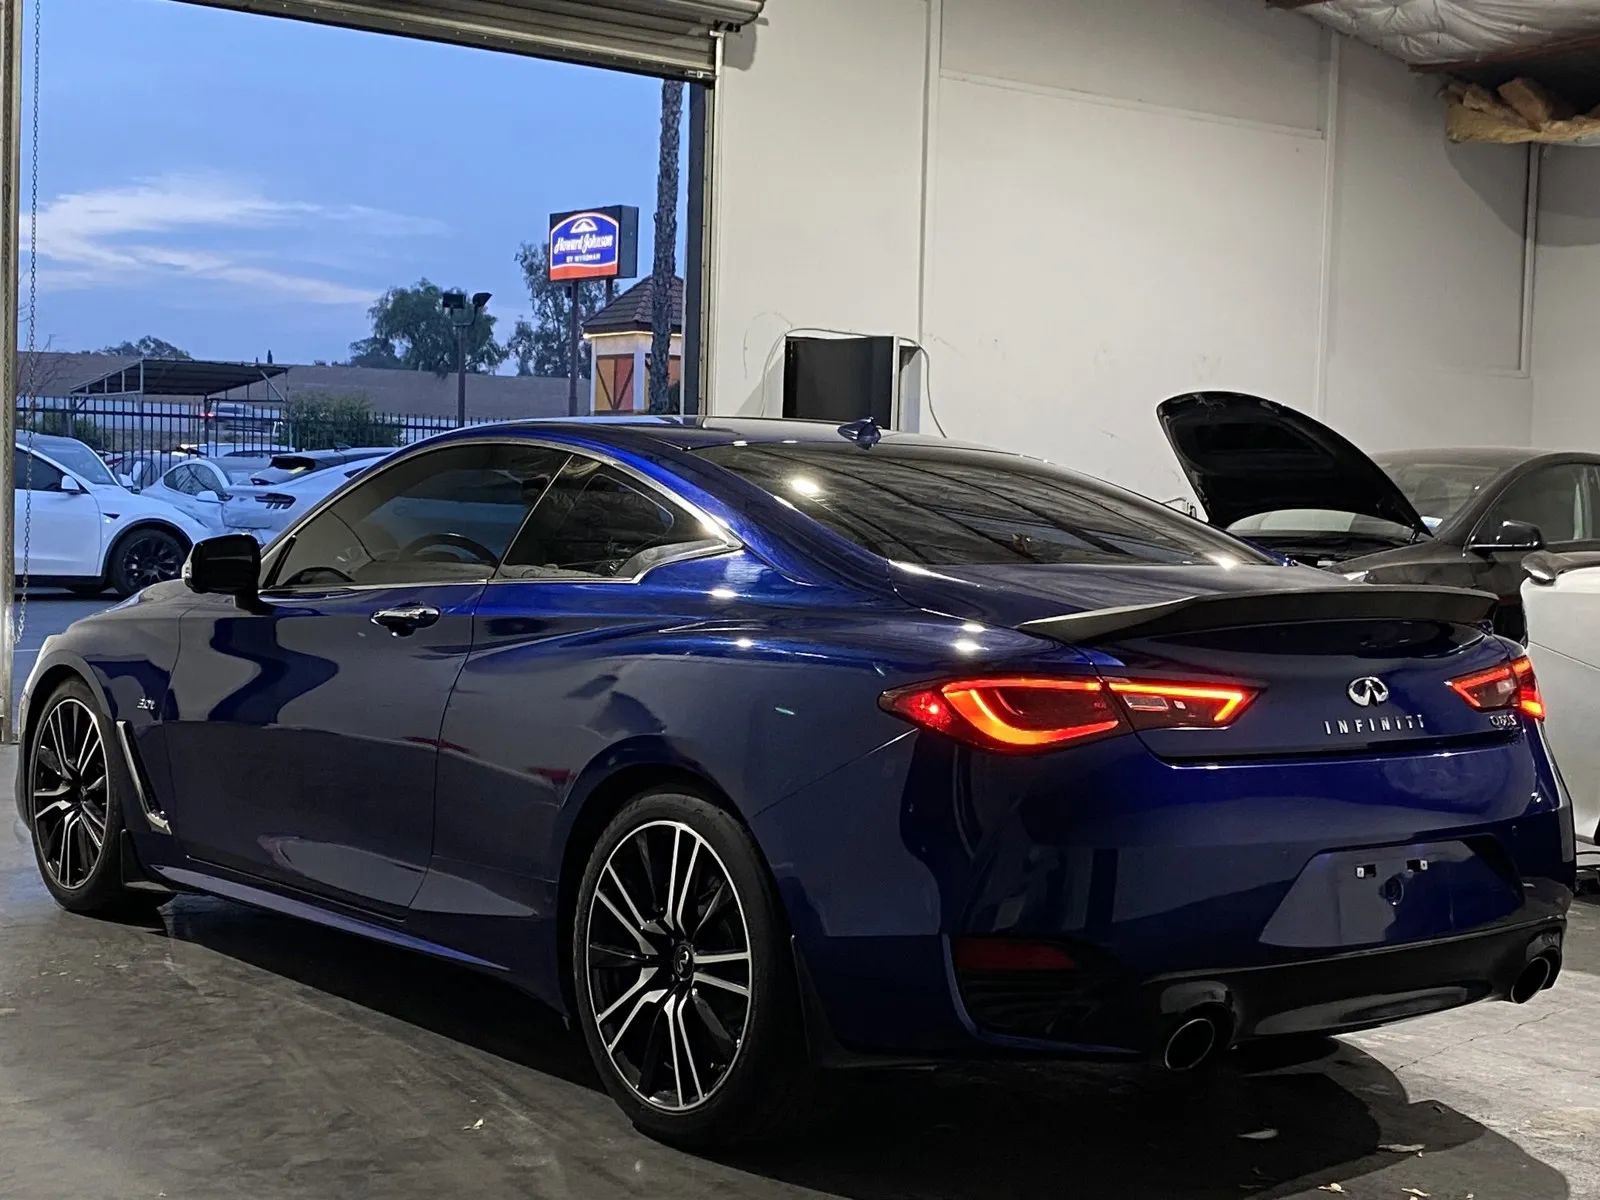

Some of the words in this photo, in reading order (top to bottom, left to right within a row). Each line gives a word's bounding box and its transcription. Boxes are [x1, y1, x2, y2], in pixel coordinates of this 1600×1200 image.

[554, 235, 584, 254] Howard
[582, 233, 613, 254] Johnson
[1324, 714, 1424, 735] INFINITI
